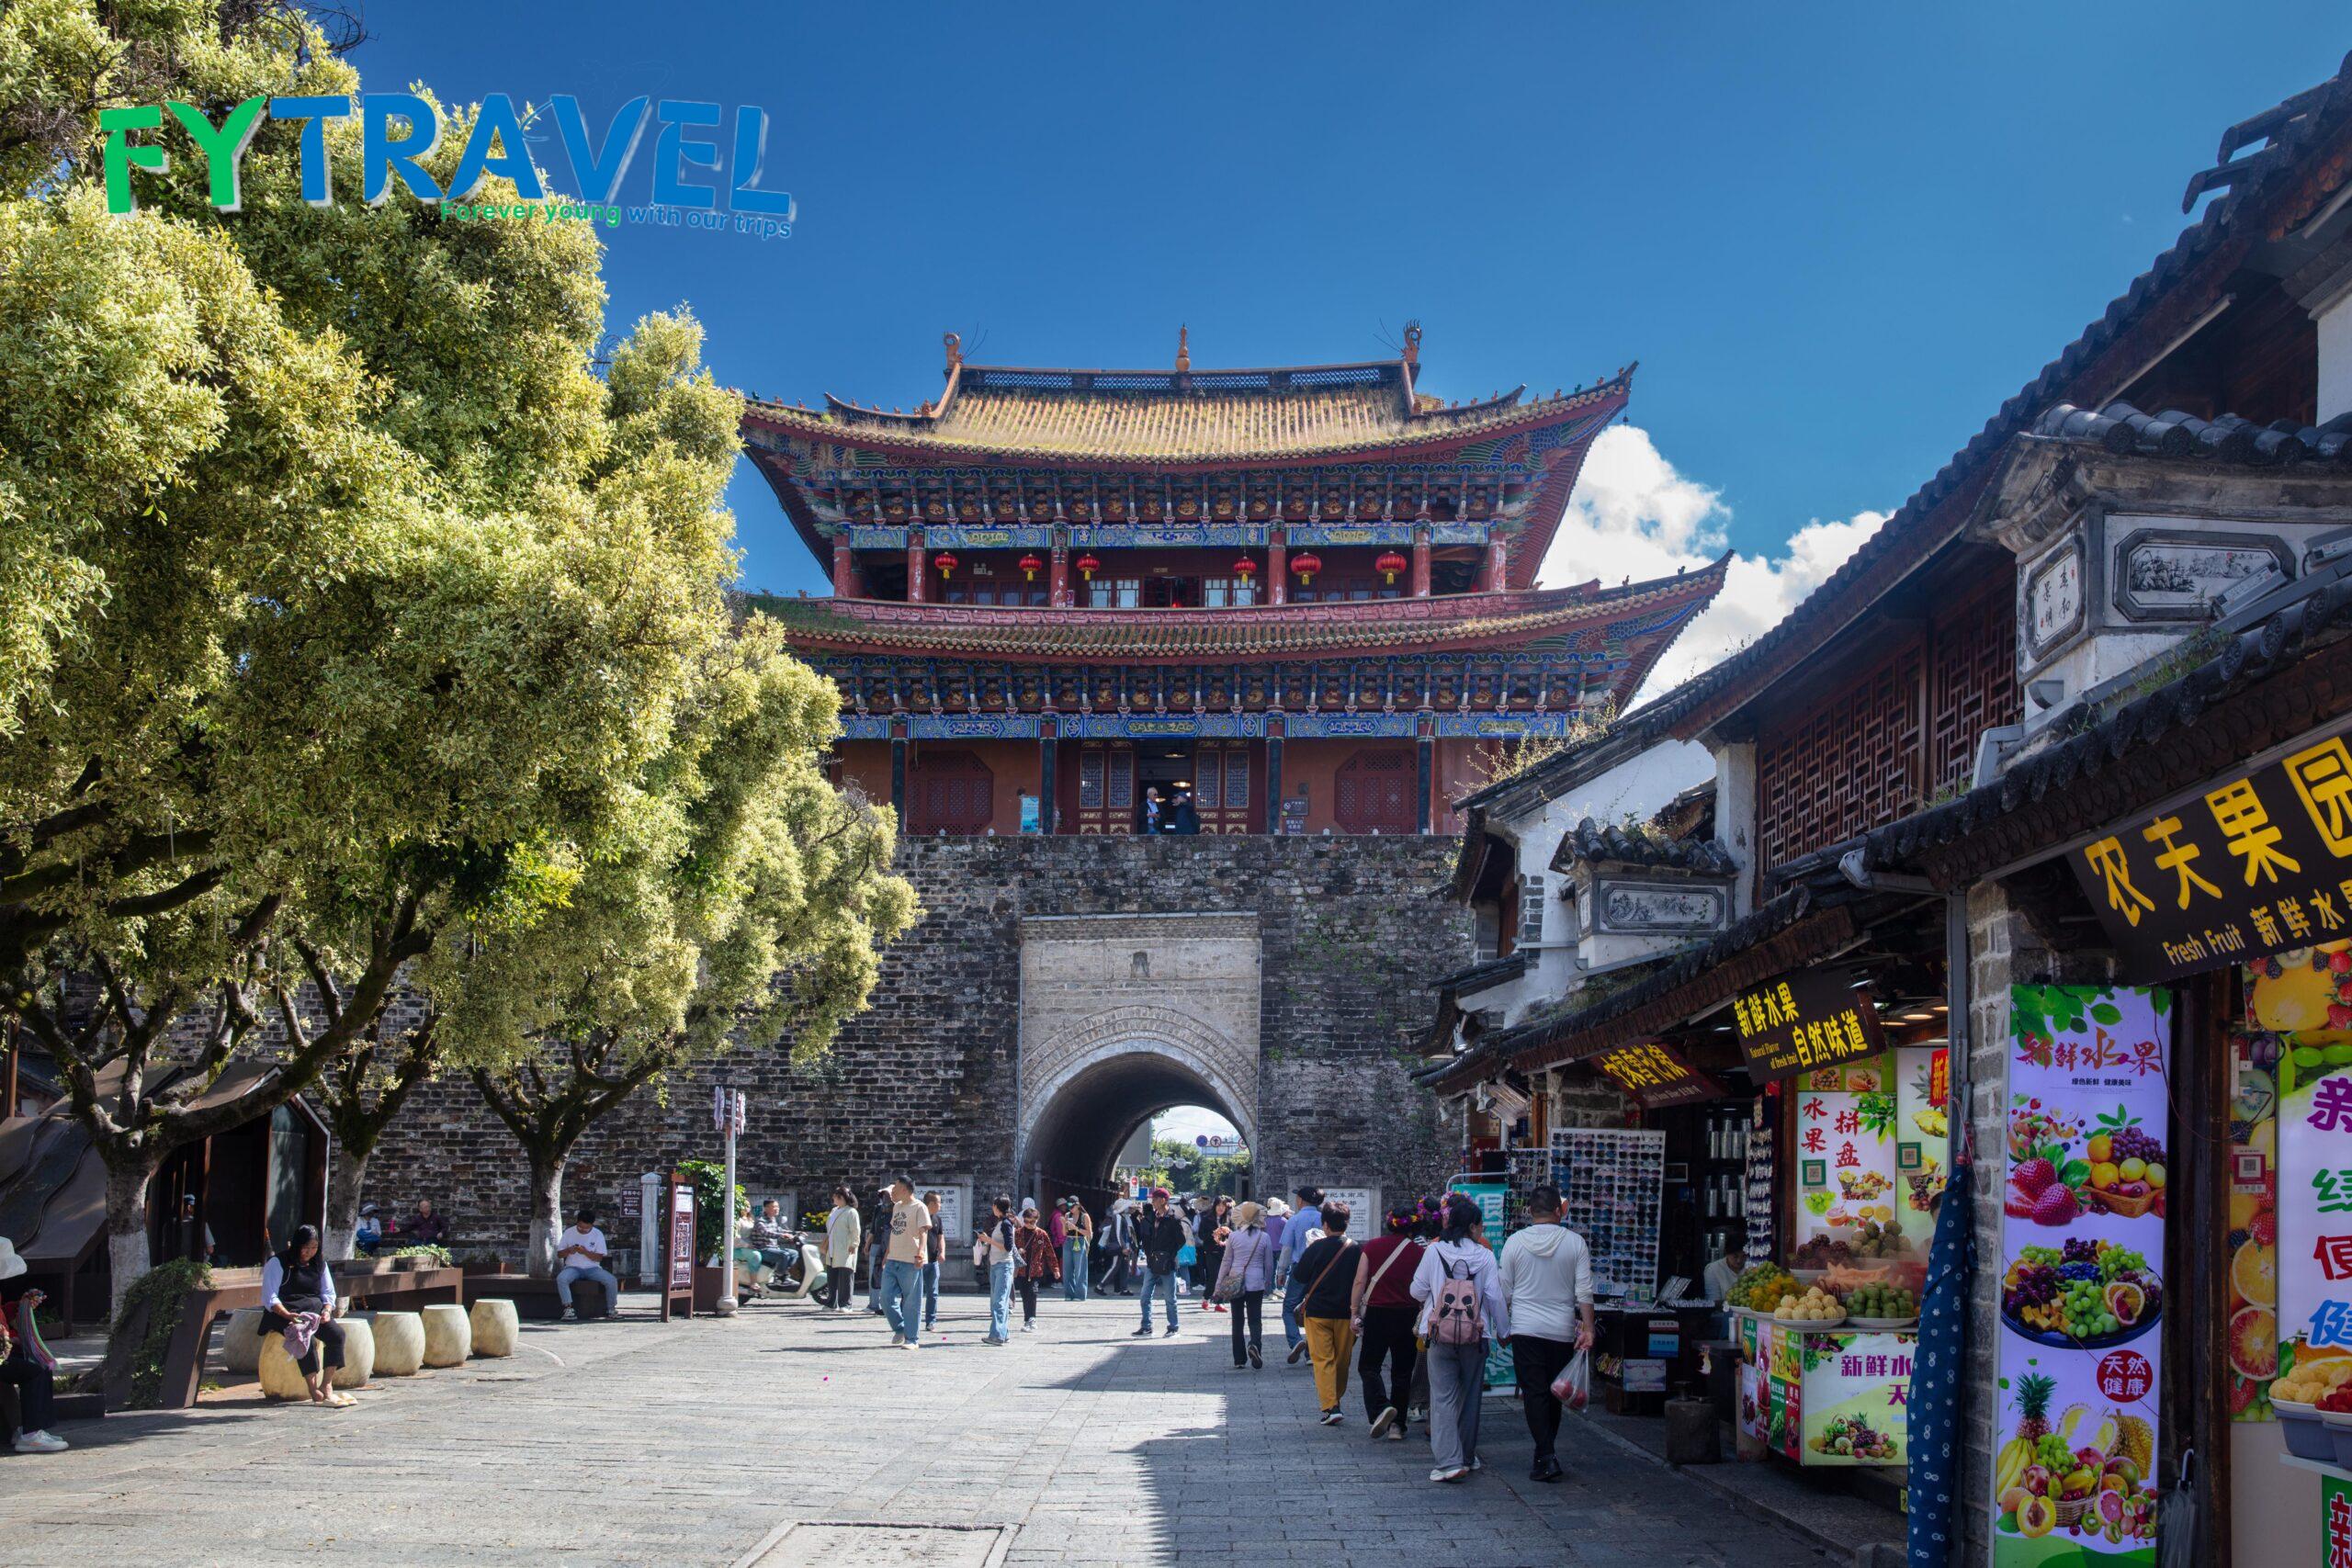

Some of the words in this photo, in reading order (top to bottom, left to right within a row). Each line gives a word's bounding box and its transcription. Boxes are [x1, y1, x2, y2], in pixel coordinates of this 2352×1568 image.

[2162, 932, 2208, 966] Fresh
[2204, 922, 2246, 956] Fruit
[1734, 981, 1800, 1039] 新鲜水果
[1792, 1008, 1869, 1068] 自然味道
[2015, 1026, 2162, 1077] 新鲜水果
[1801, 1097, 1828, 1154] 水果
[1834, 1109, 1861, 1168] 拼盘
[2104, 1377, 2146, 1396] 健康
[2105, 1355, 2146, 1375] 天然
